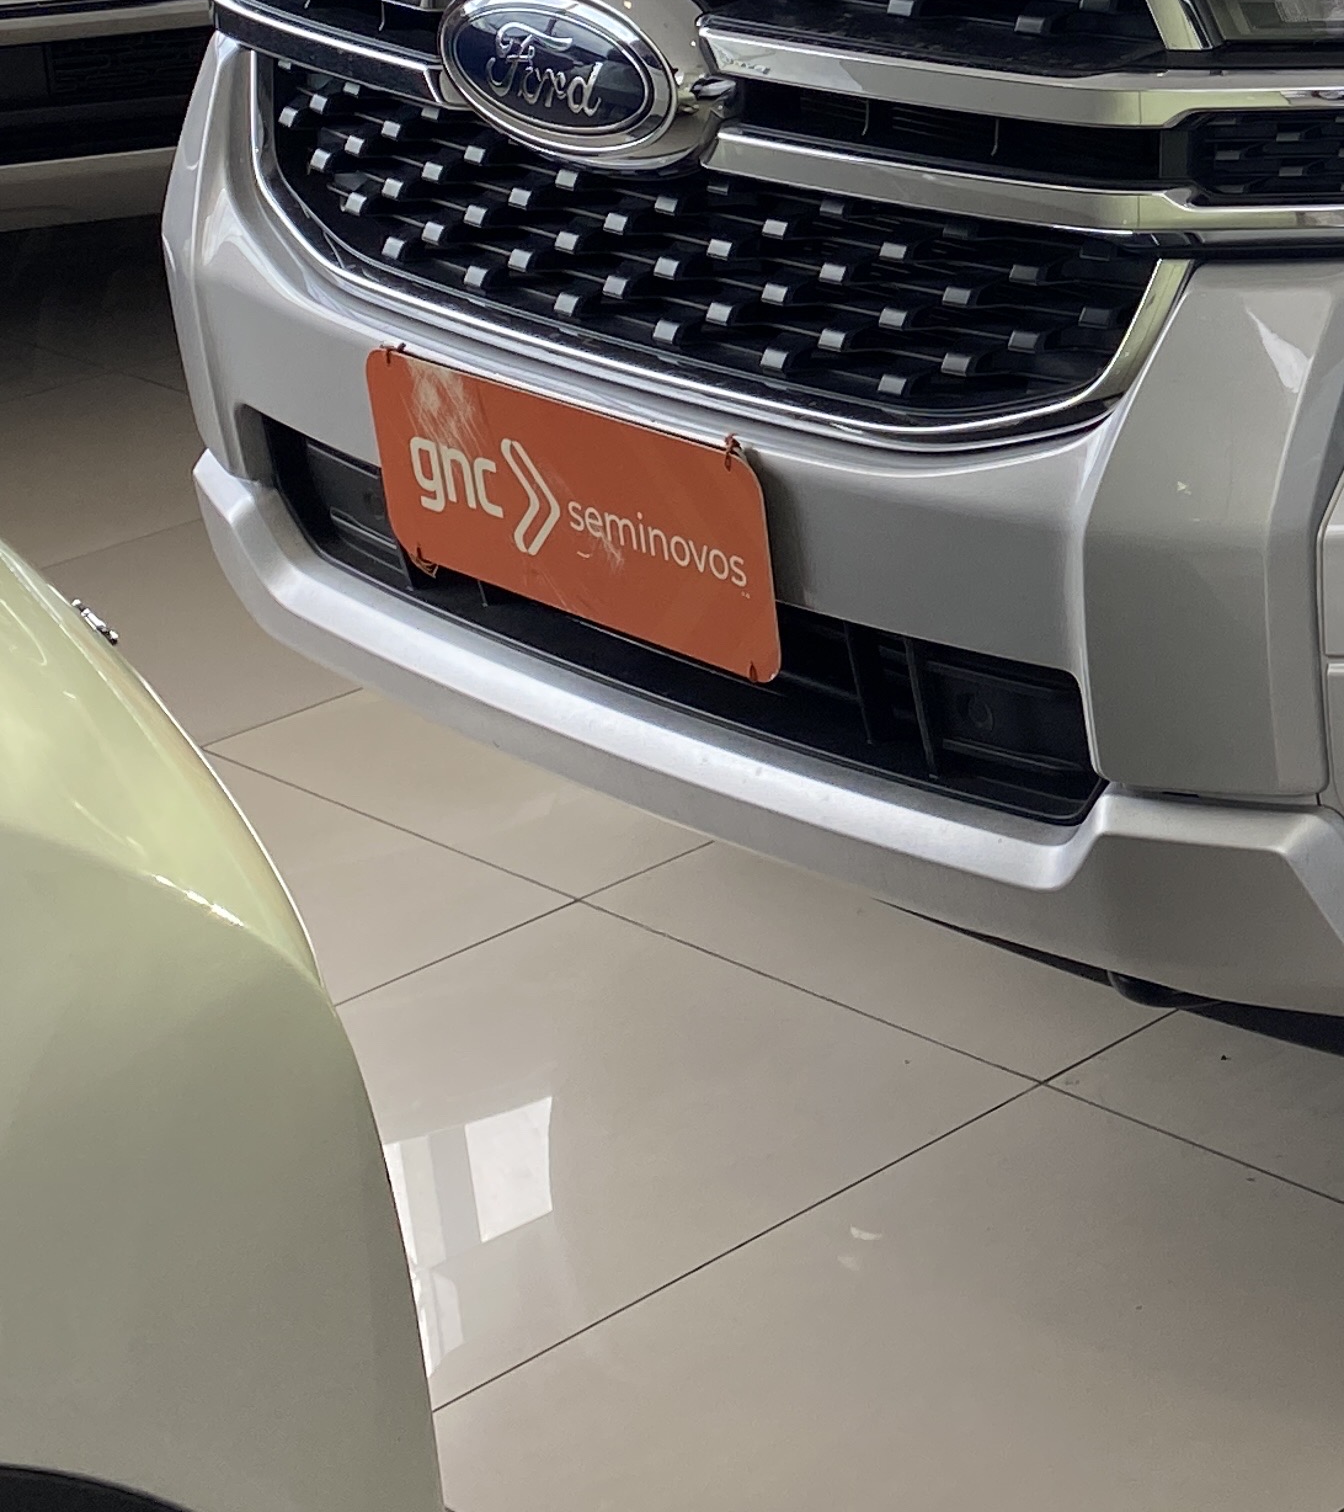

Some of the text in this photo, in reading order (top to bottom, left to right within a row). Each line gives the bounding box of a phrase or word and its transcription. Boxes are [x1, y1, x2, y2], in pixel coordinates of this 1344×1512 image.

[485, 21, 604, 118] Ford
[409, 436, 748, 588] gnc seminovos
